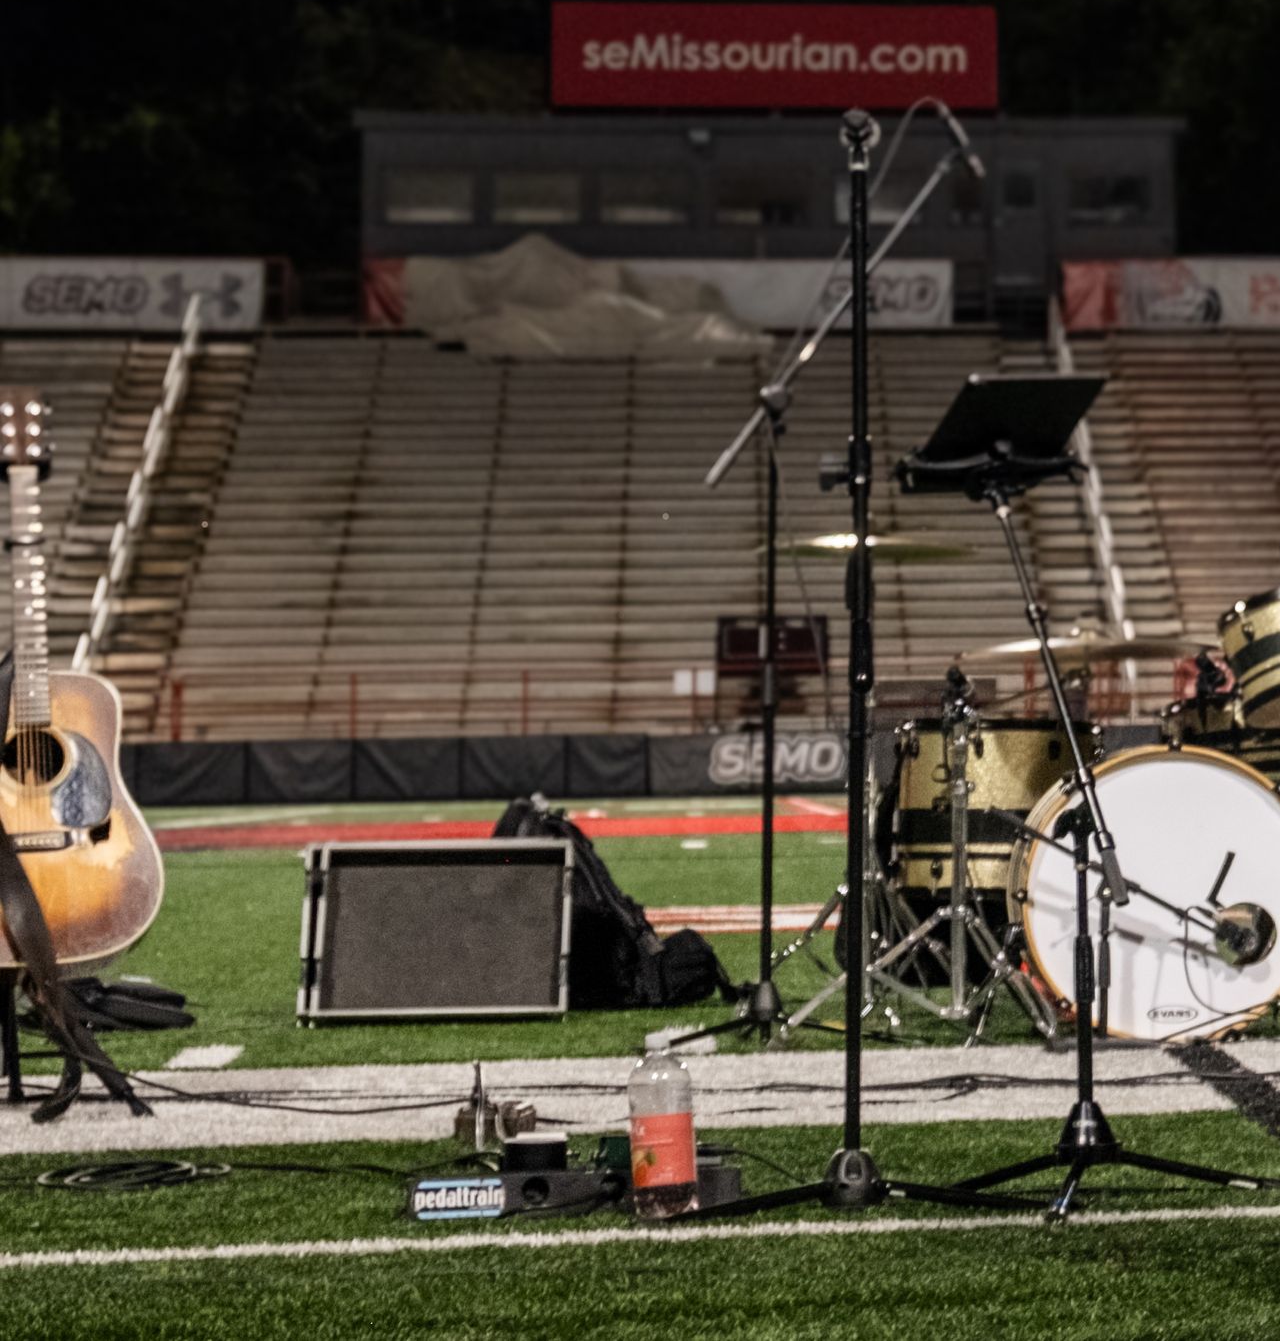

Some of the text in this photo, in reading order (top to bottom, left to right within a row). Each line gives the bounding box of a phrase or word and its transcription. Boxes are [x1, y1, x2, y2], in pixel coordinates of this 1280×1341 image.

[582, 34, 968, 73] seMissourian.com
[22, 273, 149, 315] SEMO
[413, 1185, 506, 1213] pedaltrain
